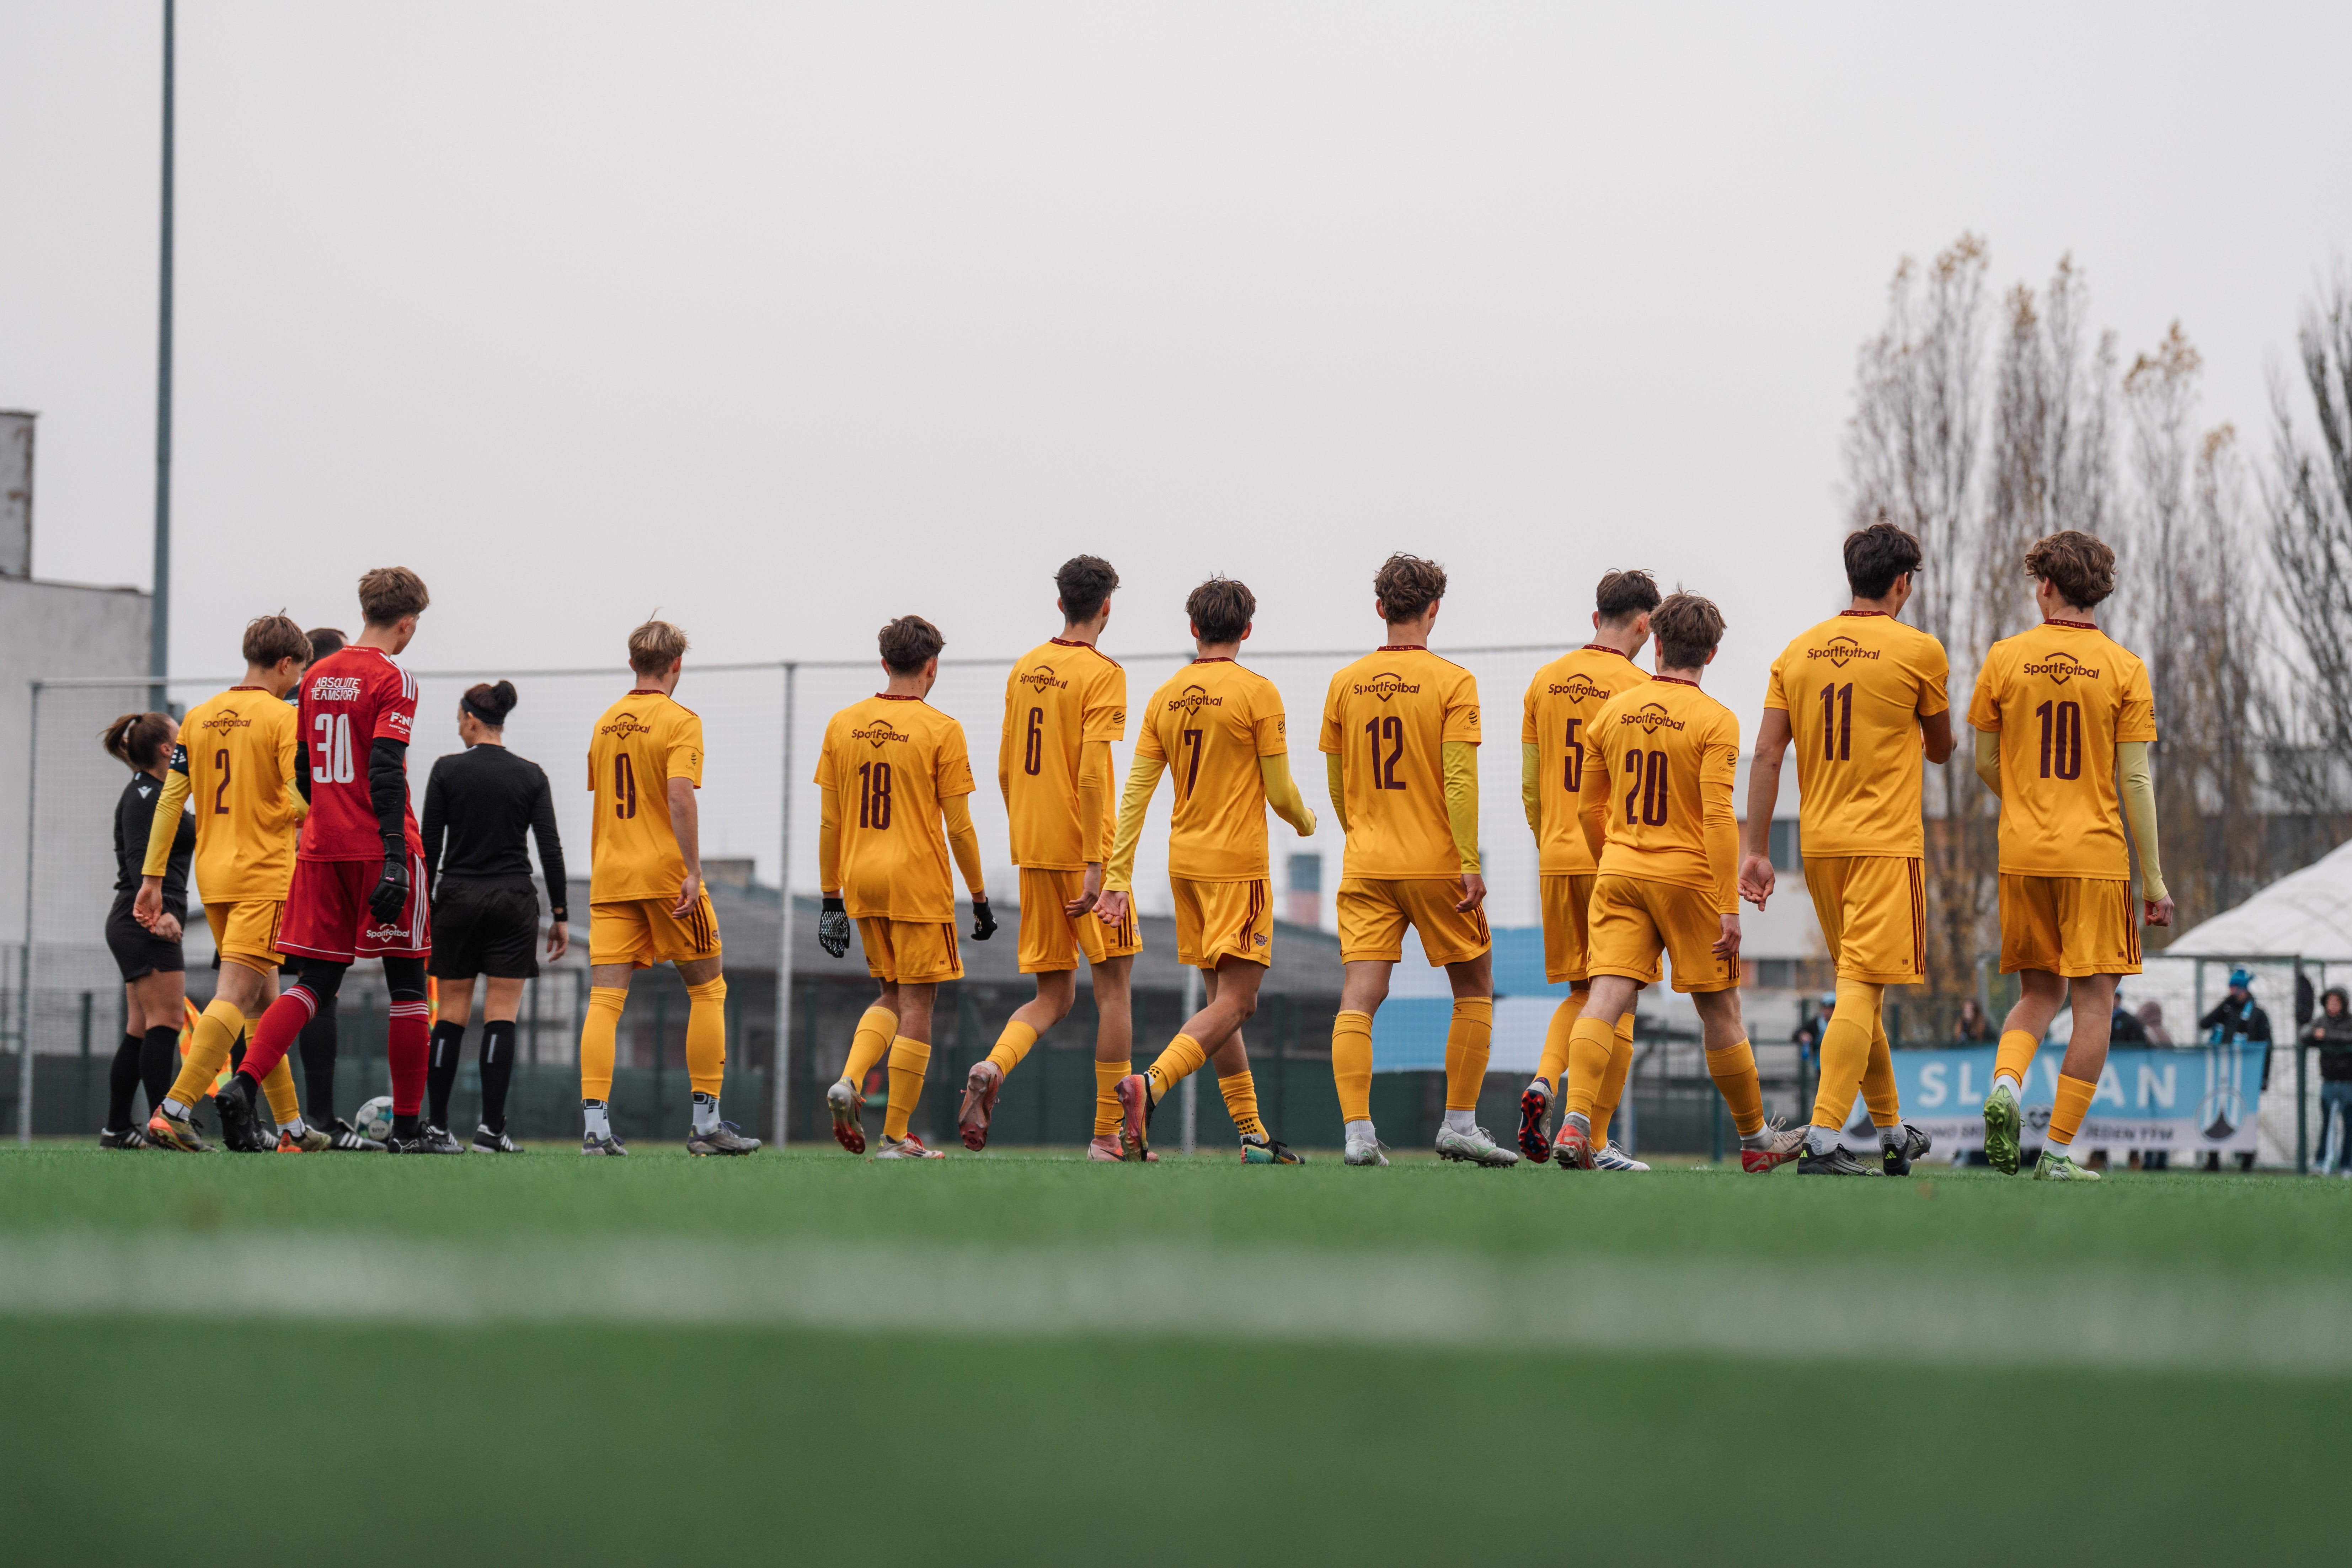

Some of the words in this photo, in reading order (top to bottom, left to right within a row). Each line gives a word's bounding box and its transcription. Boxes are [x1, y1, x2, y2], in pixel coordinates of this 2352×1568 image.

[1807, 646, 1880, 660] SportFotbal
[2024, 663, 2100, 679] SportFotbal
[315, 677, 361, 689] ABSOLUTE
[1020, 673, 1068, 689] SportFotbal
[1354, 681, 1420, 695] SportFotbal
[311, 689, 360, 702] TEAMSPORT
[1548, 683, 1610, 700] SportFotbal
[1168, 695, 1223, 712] SportFotbal
[202, 718, 252, 729] SportFotbal
[601, 722, 651, 735] SportFotbal
[1620, 713, 1685, 731] SportFotbal
[1820, 682, 1853, 761] 11
[851, 729, 909, 743] SportFotbal
[1025, 707, 1043, 776] 6
[2036, 700, 2081, 781] 10
[313, 713, 354, 784] 30
[1365, 716, 1406, 790] 12
[1564, 718, 1584, 792] 5
[1183, 729, 1203, 801] 7
[215, 749, 231, 814] 2
[615, 753, 636, 819] 9
[1625, 749, 1668, 827] 20
[859, 761, 891, 830] 18
[366, 929, 410, 939] SportFotbal
